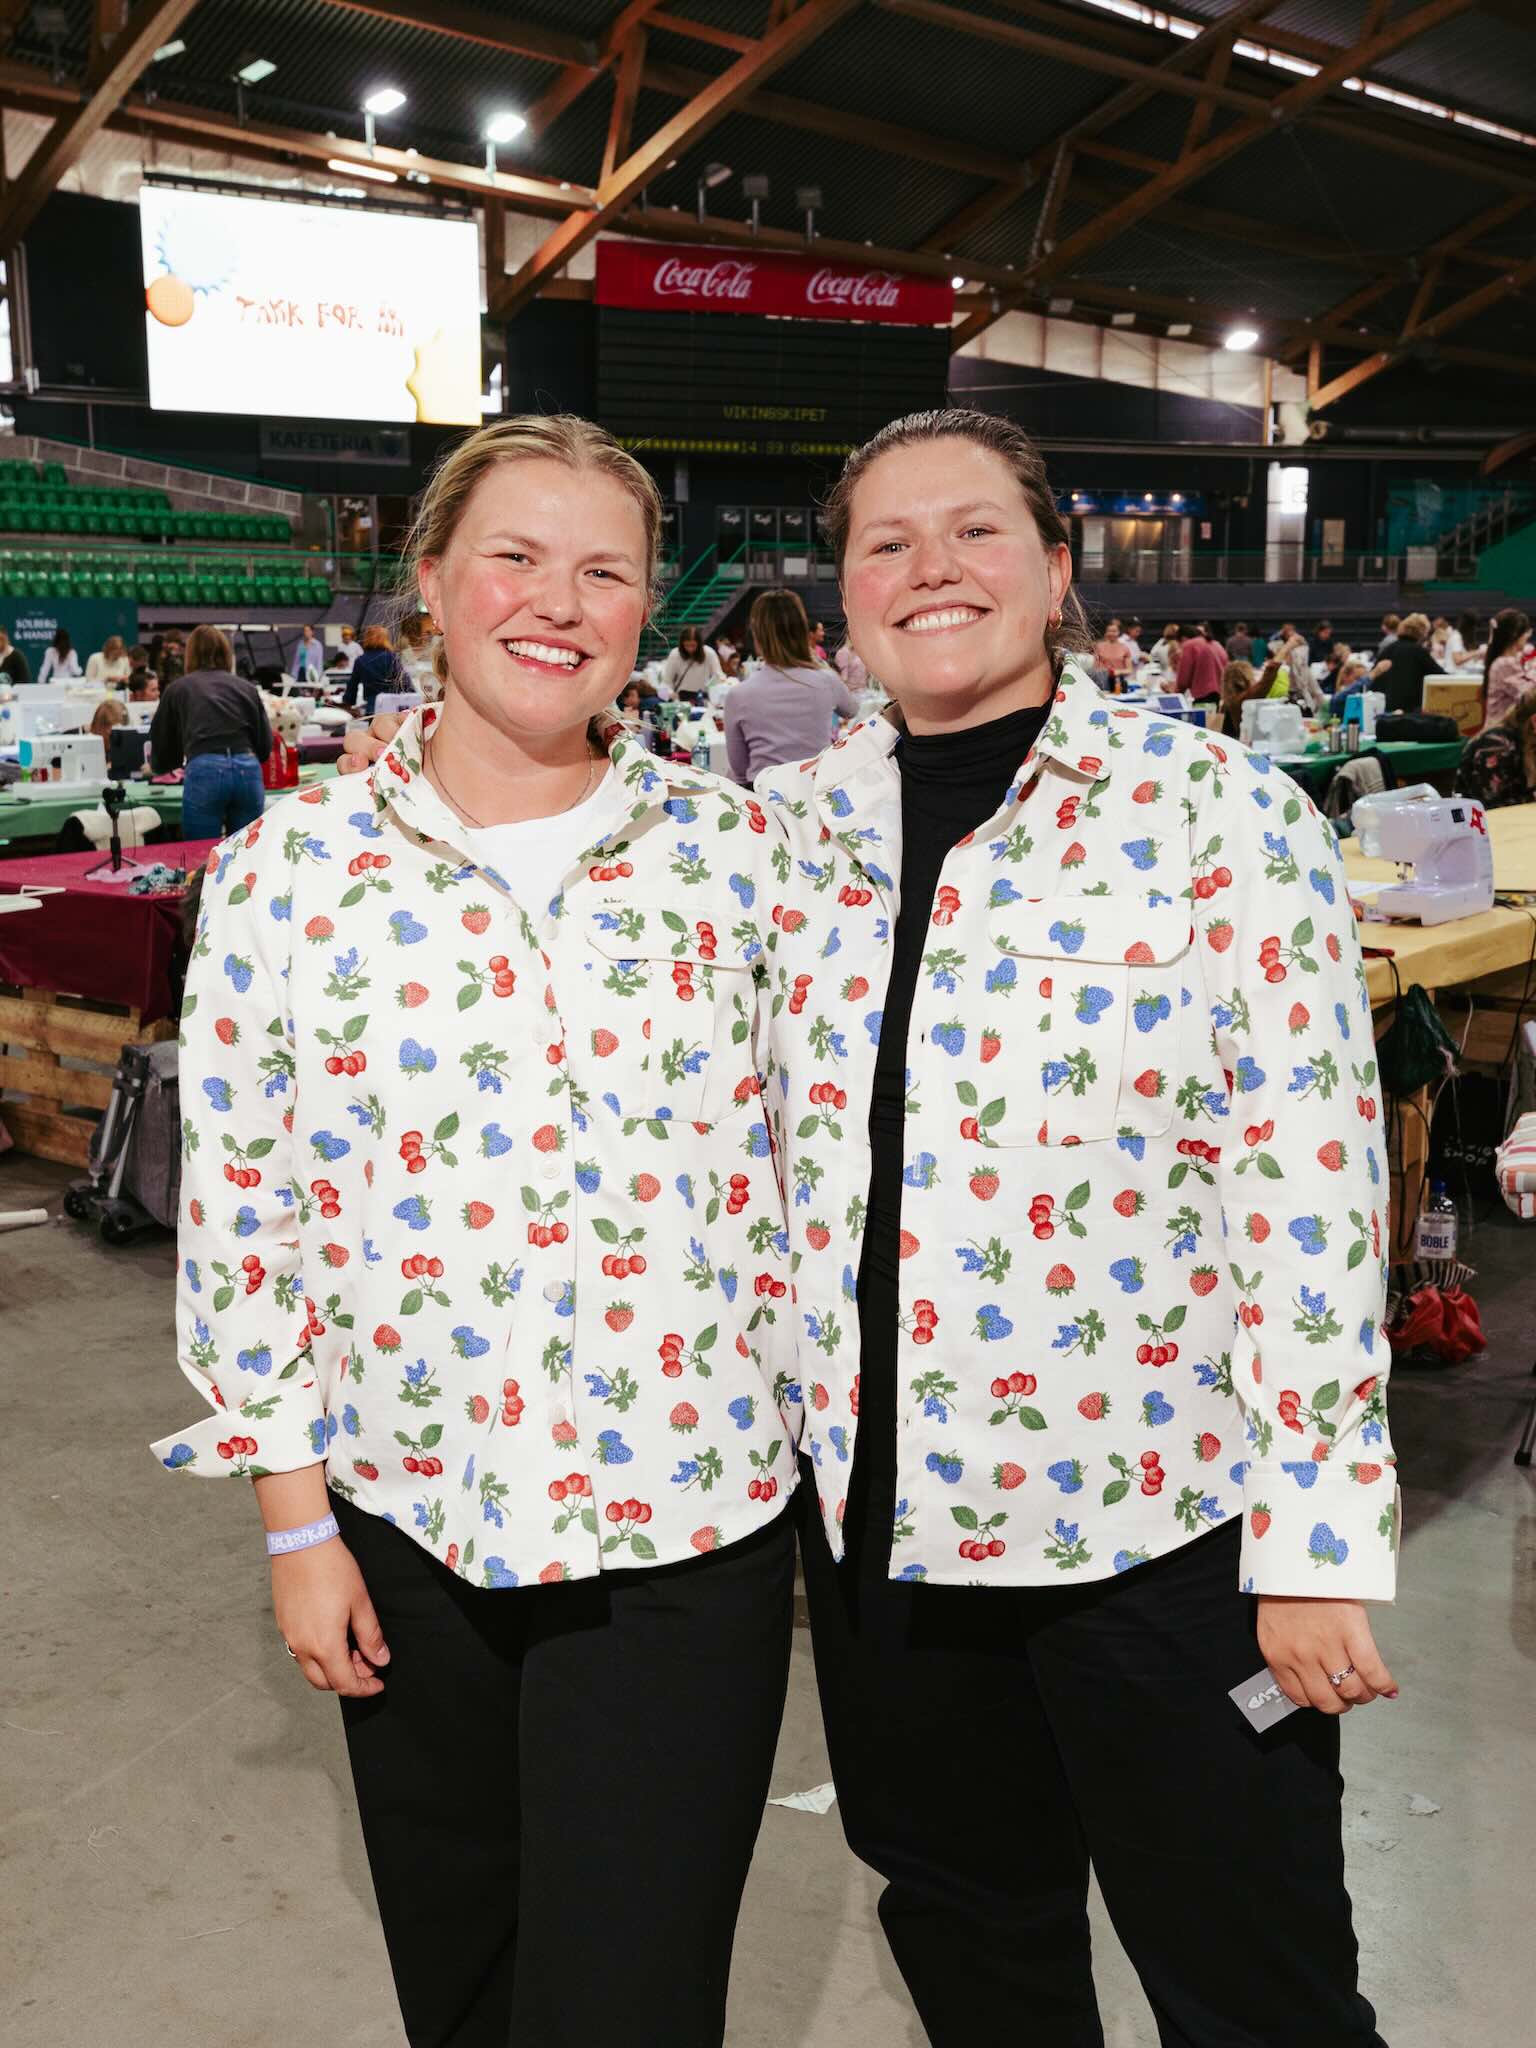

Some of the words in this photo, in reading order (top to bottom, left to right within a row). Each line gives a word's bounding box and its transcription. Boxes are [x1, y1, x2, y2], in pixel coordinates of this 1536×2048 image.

[653, 257, 756, 298] Coca-Cola
[806, 267, 902, 306] Coca-Cola
[1421, 1234, 1448, 1249] BOBLE
